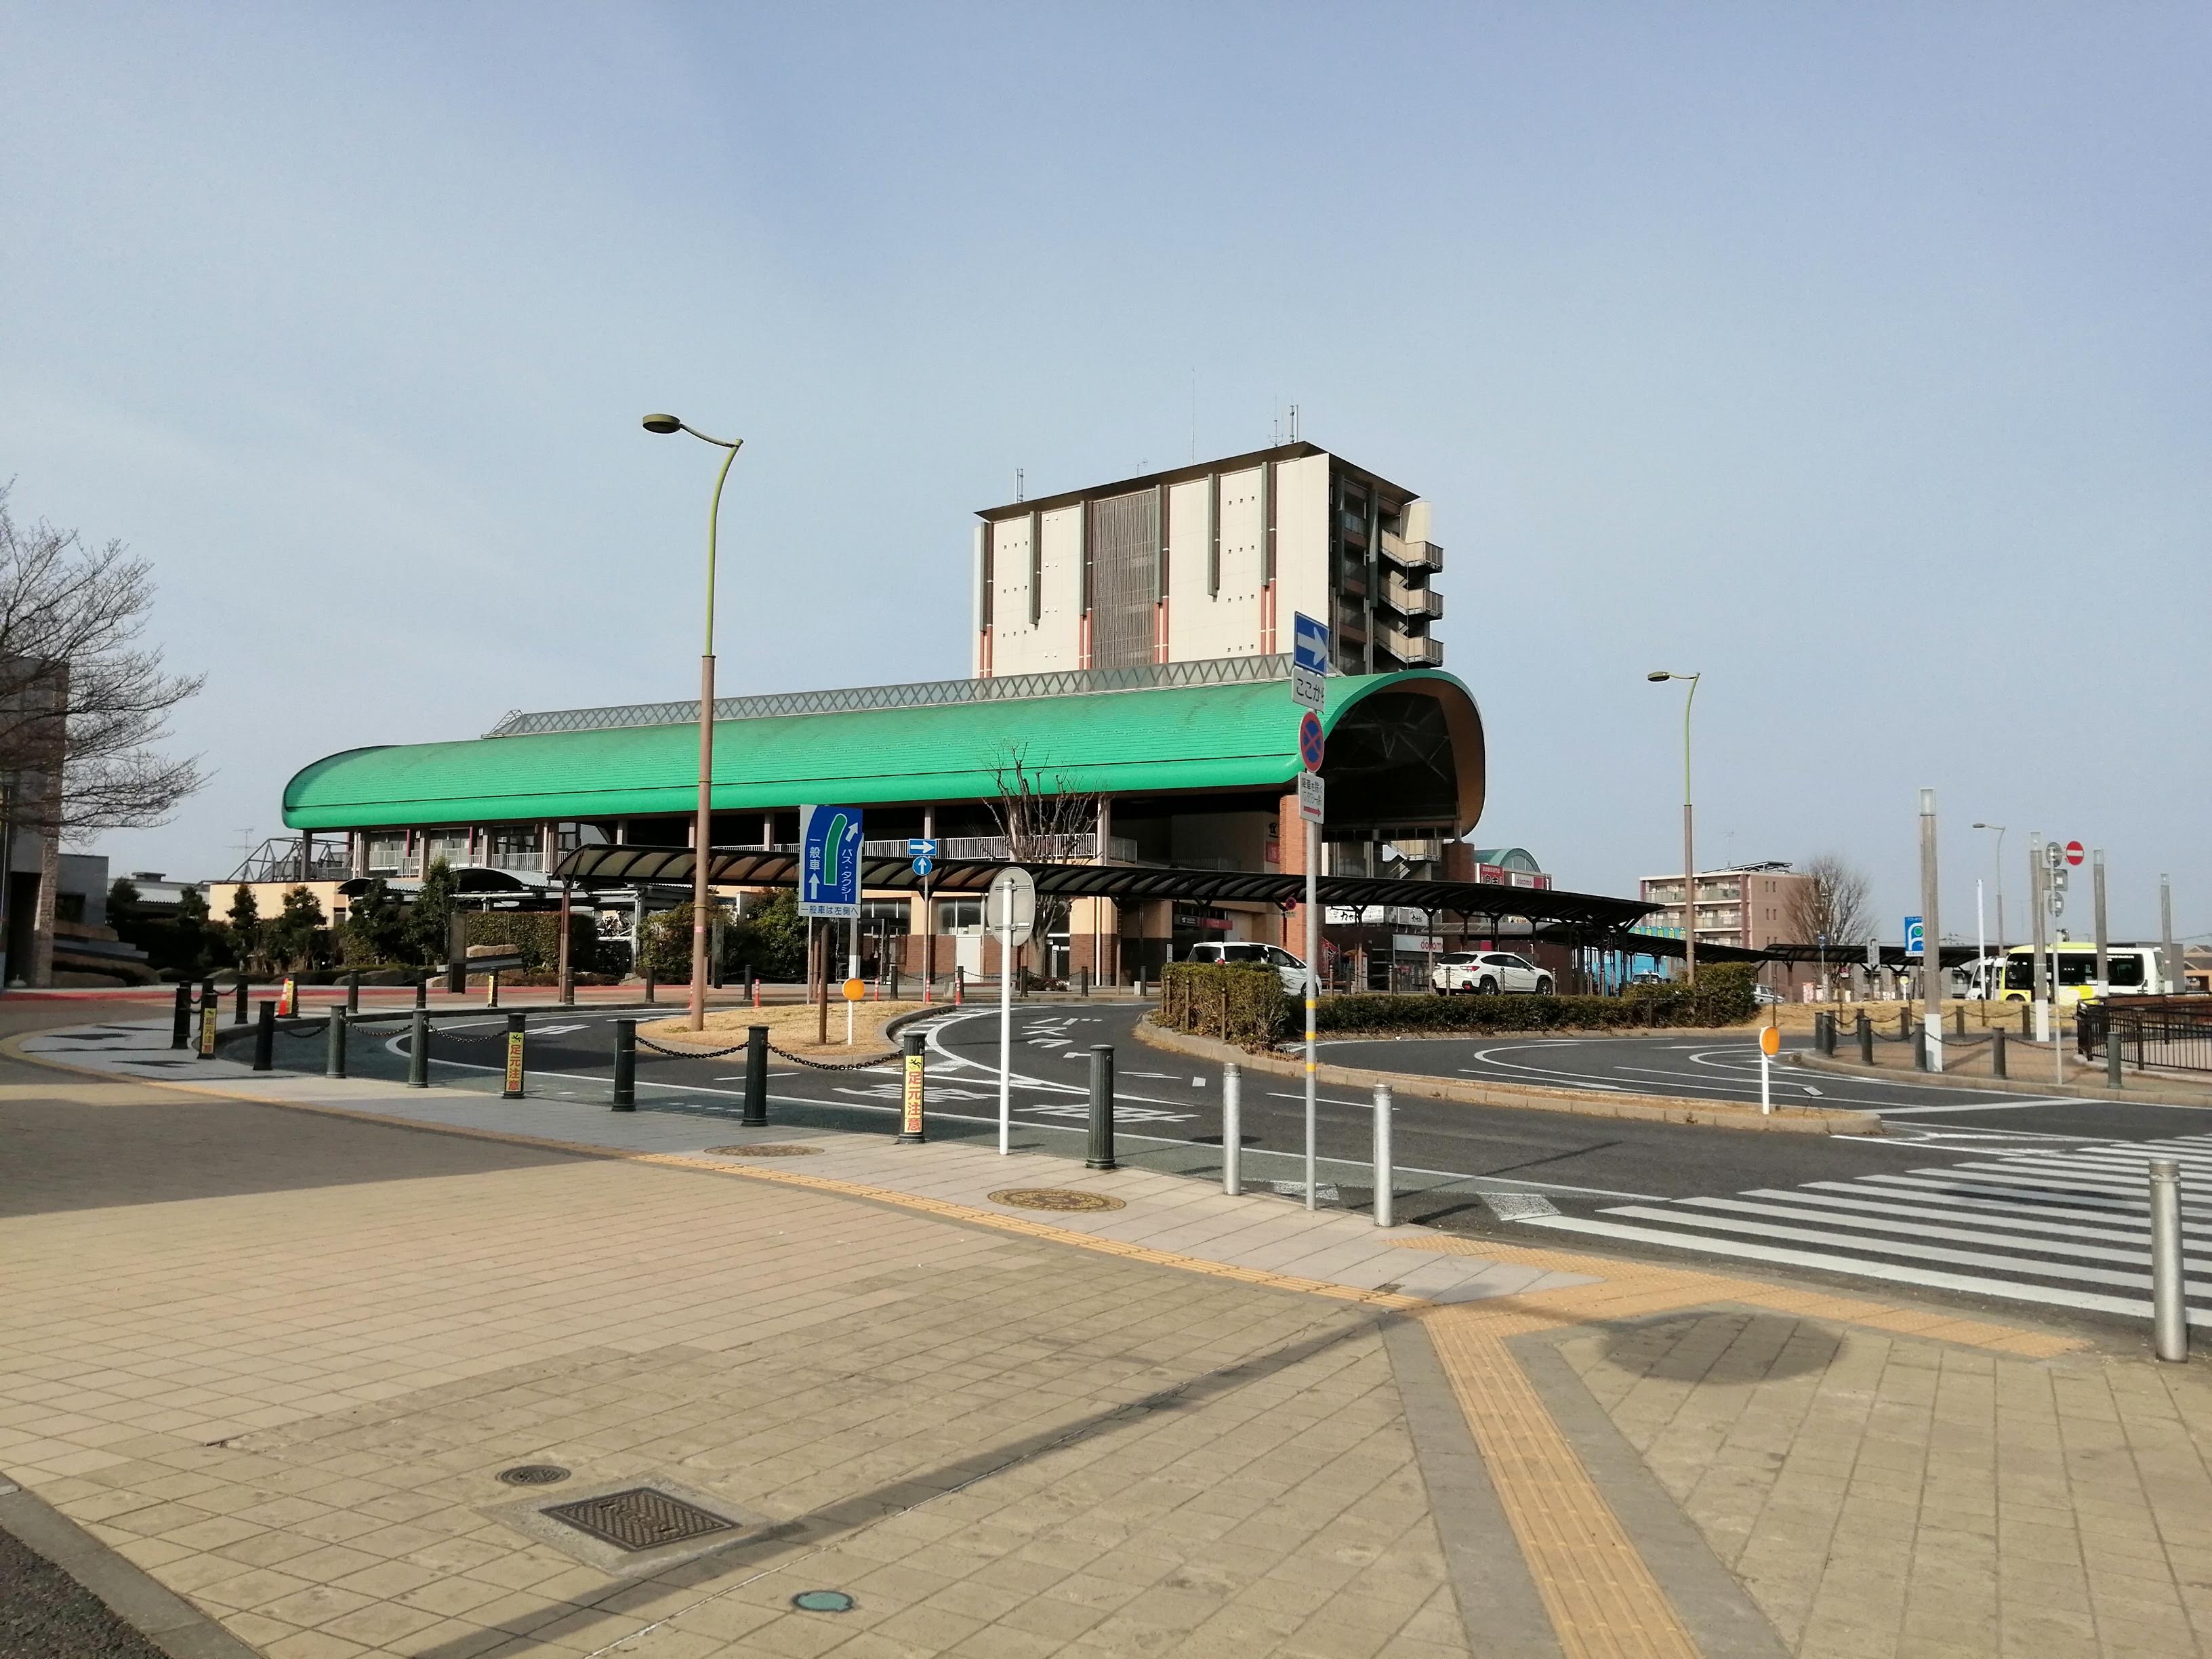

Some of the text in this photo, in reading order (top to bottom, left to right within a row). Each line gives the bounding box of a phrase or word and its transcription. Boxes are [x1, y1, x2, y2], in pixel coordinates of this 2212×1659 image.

[809, 838, 821, 872] 一般車
[842, 848, 853, 902] バス・タクシー
[800, 905, 859, 916] 一般車は左側へ
[1420, 939, 1443, 951] doom
[510, 1044, 521, 1090] 足元注意
[907, 1071, 922, 1131] 足元注意
